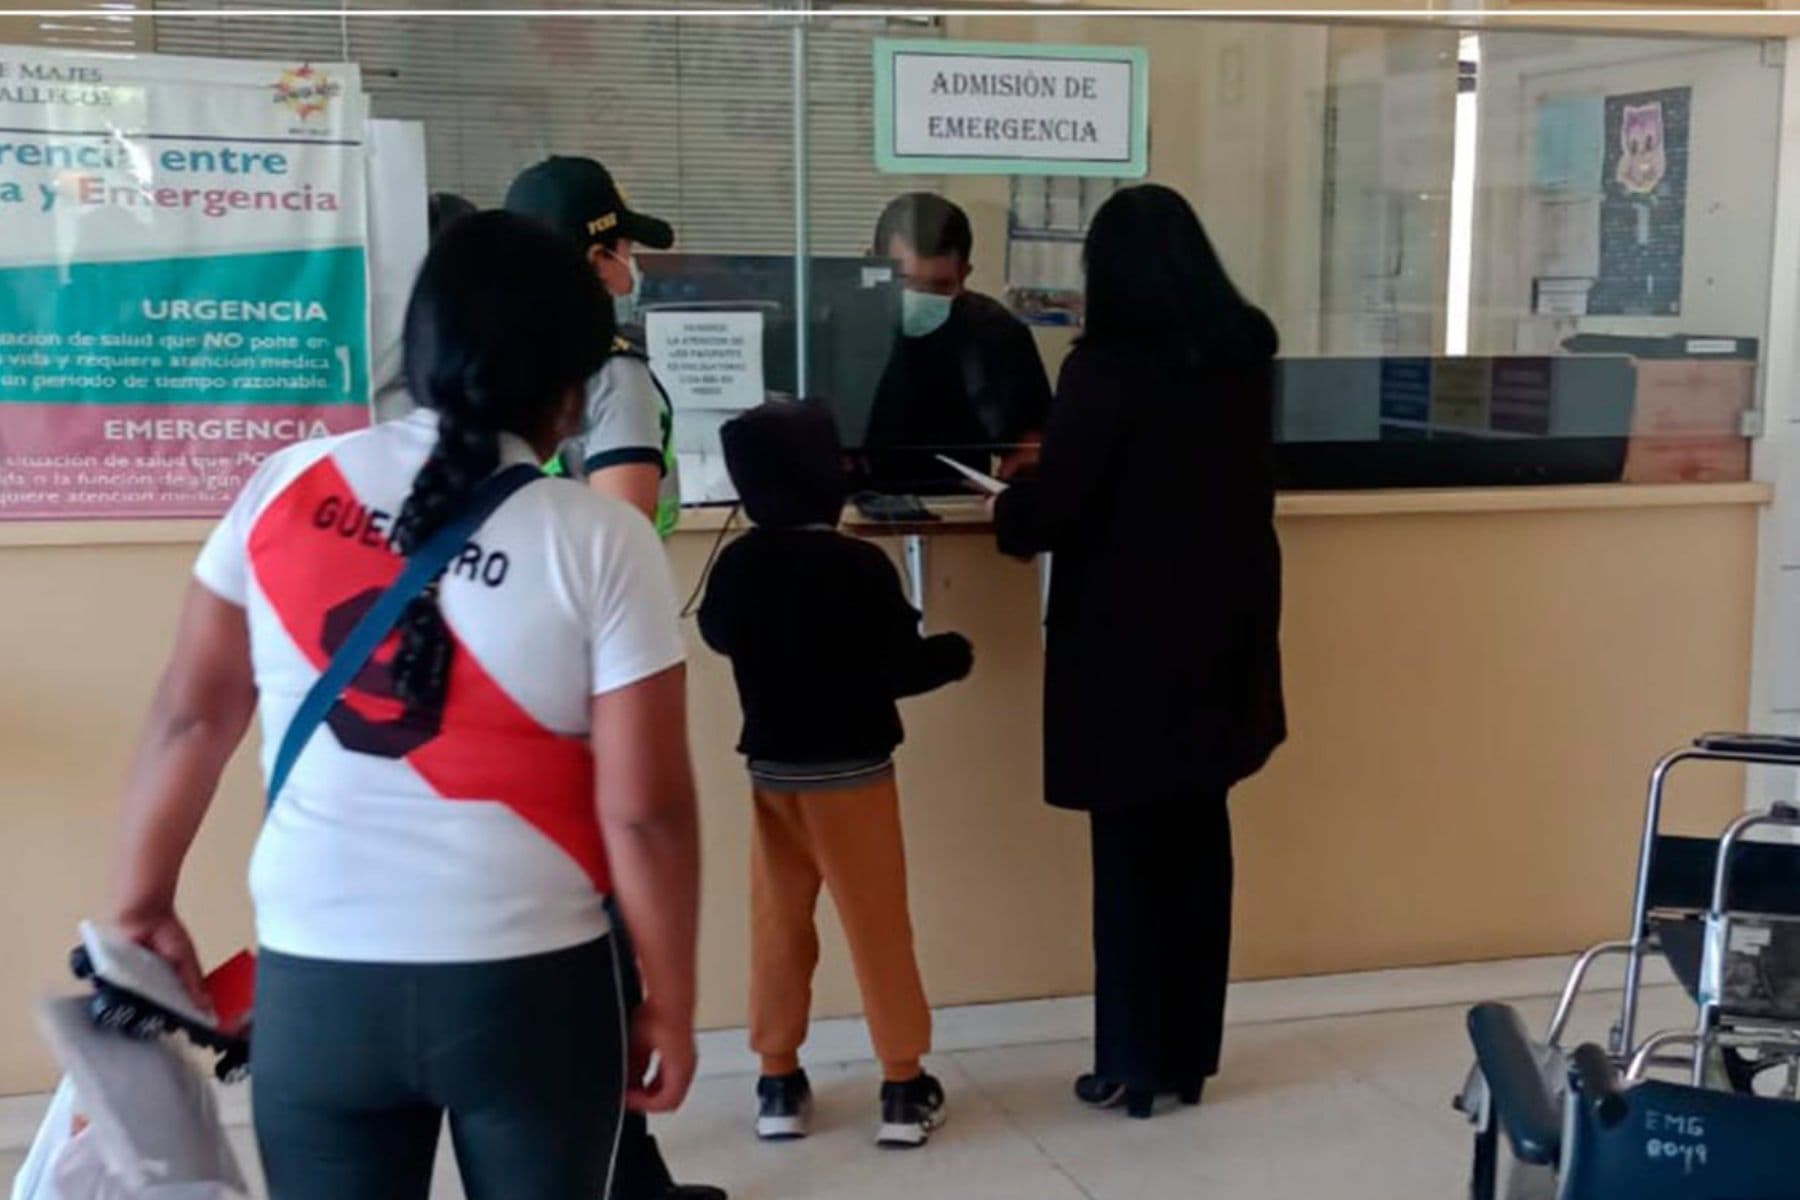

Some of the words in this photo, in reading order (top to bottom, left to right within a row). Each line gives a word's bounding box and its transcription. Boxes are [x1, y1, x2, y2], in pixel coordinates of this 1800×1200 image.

[20, 64, 103, 82] MAJES
[931, 69, 1056, 98] ADMISIÓN
[1064, 77, 1098, 99] DE
[927, 115, 1099, 142] EMERGENCIA
[161, 148, 288, 174] entre
[39, 183, 56, 212] y
[78, 177, 339, 217] Emergencia
[142, 299, 328, 322] URGENCIA
[203, 332, 243, 349] NO
[104, 420, 331, 441] EMERGENCIA
[314, 495, 509, 588] GUERO
[1645, 1109, 1704, 1137] EMG
